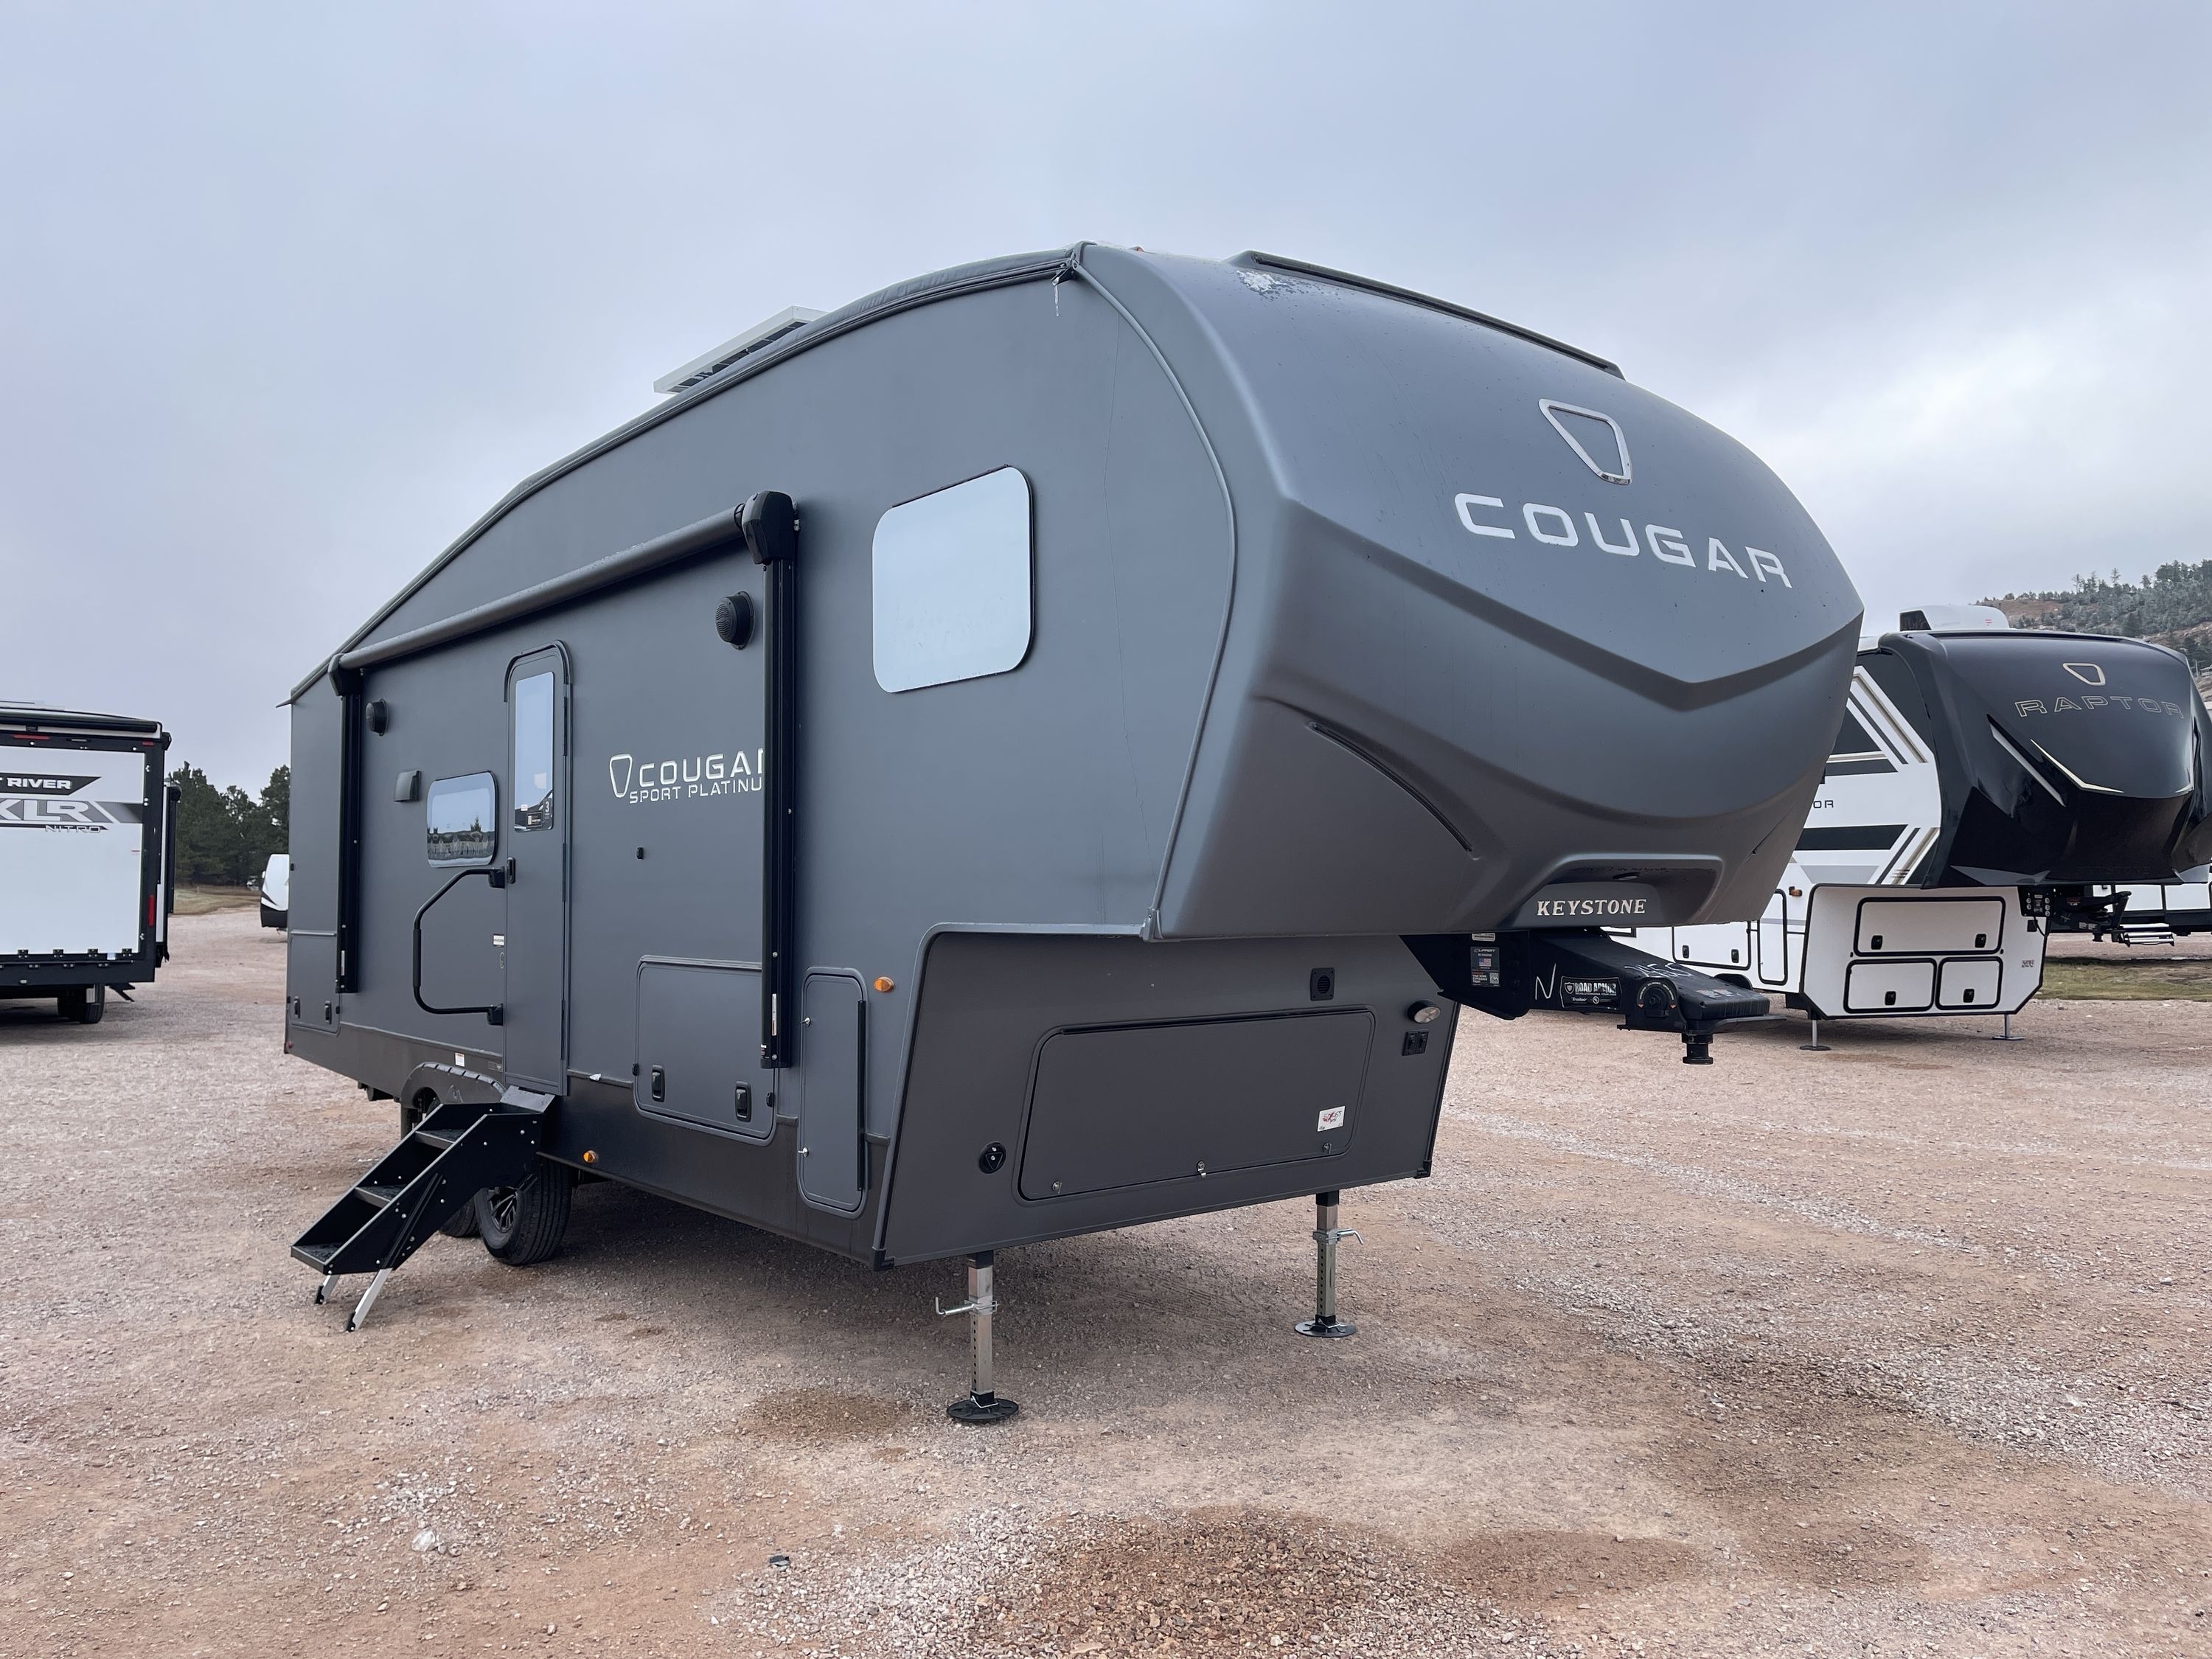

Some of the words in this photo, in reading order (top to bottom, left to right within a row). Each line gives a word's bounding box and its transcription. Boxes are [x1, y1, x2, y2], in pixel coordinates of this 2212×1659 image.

[1454, 493, 1792, 588] COUGAR
[2014, 695, 2185, 719] RAPTOR
[6, 777, 72, 790] RIVER
[629, 786, 681, 804] SPORT
[688, 776, 762, 798] PLATINU
[45, 824, 101, 834] NITRO
[1536, 899, 1647, 916] KEYSTONE
[1575, 982, 1593, 992] ROAD
